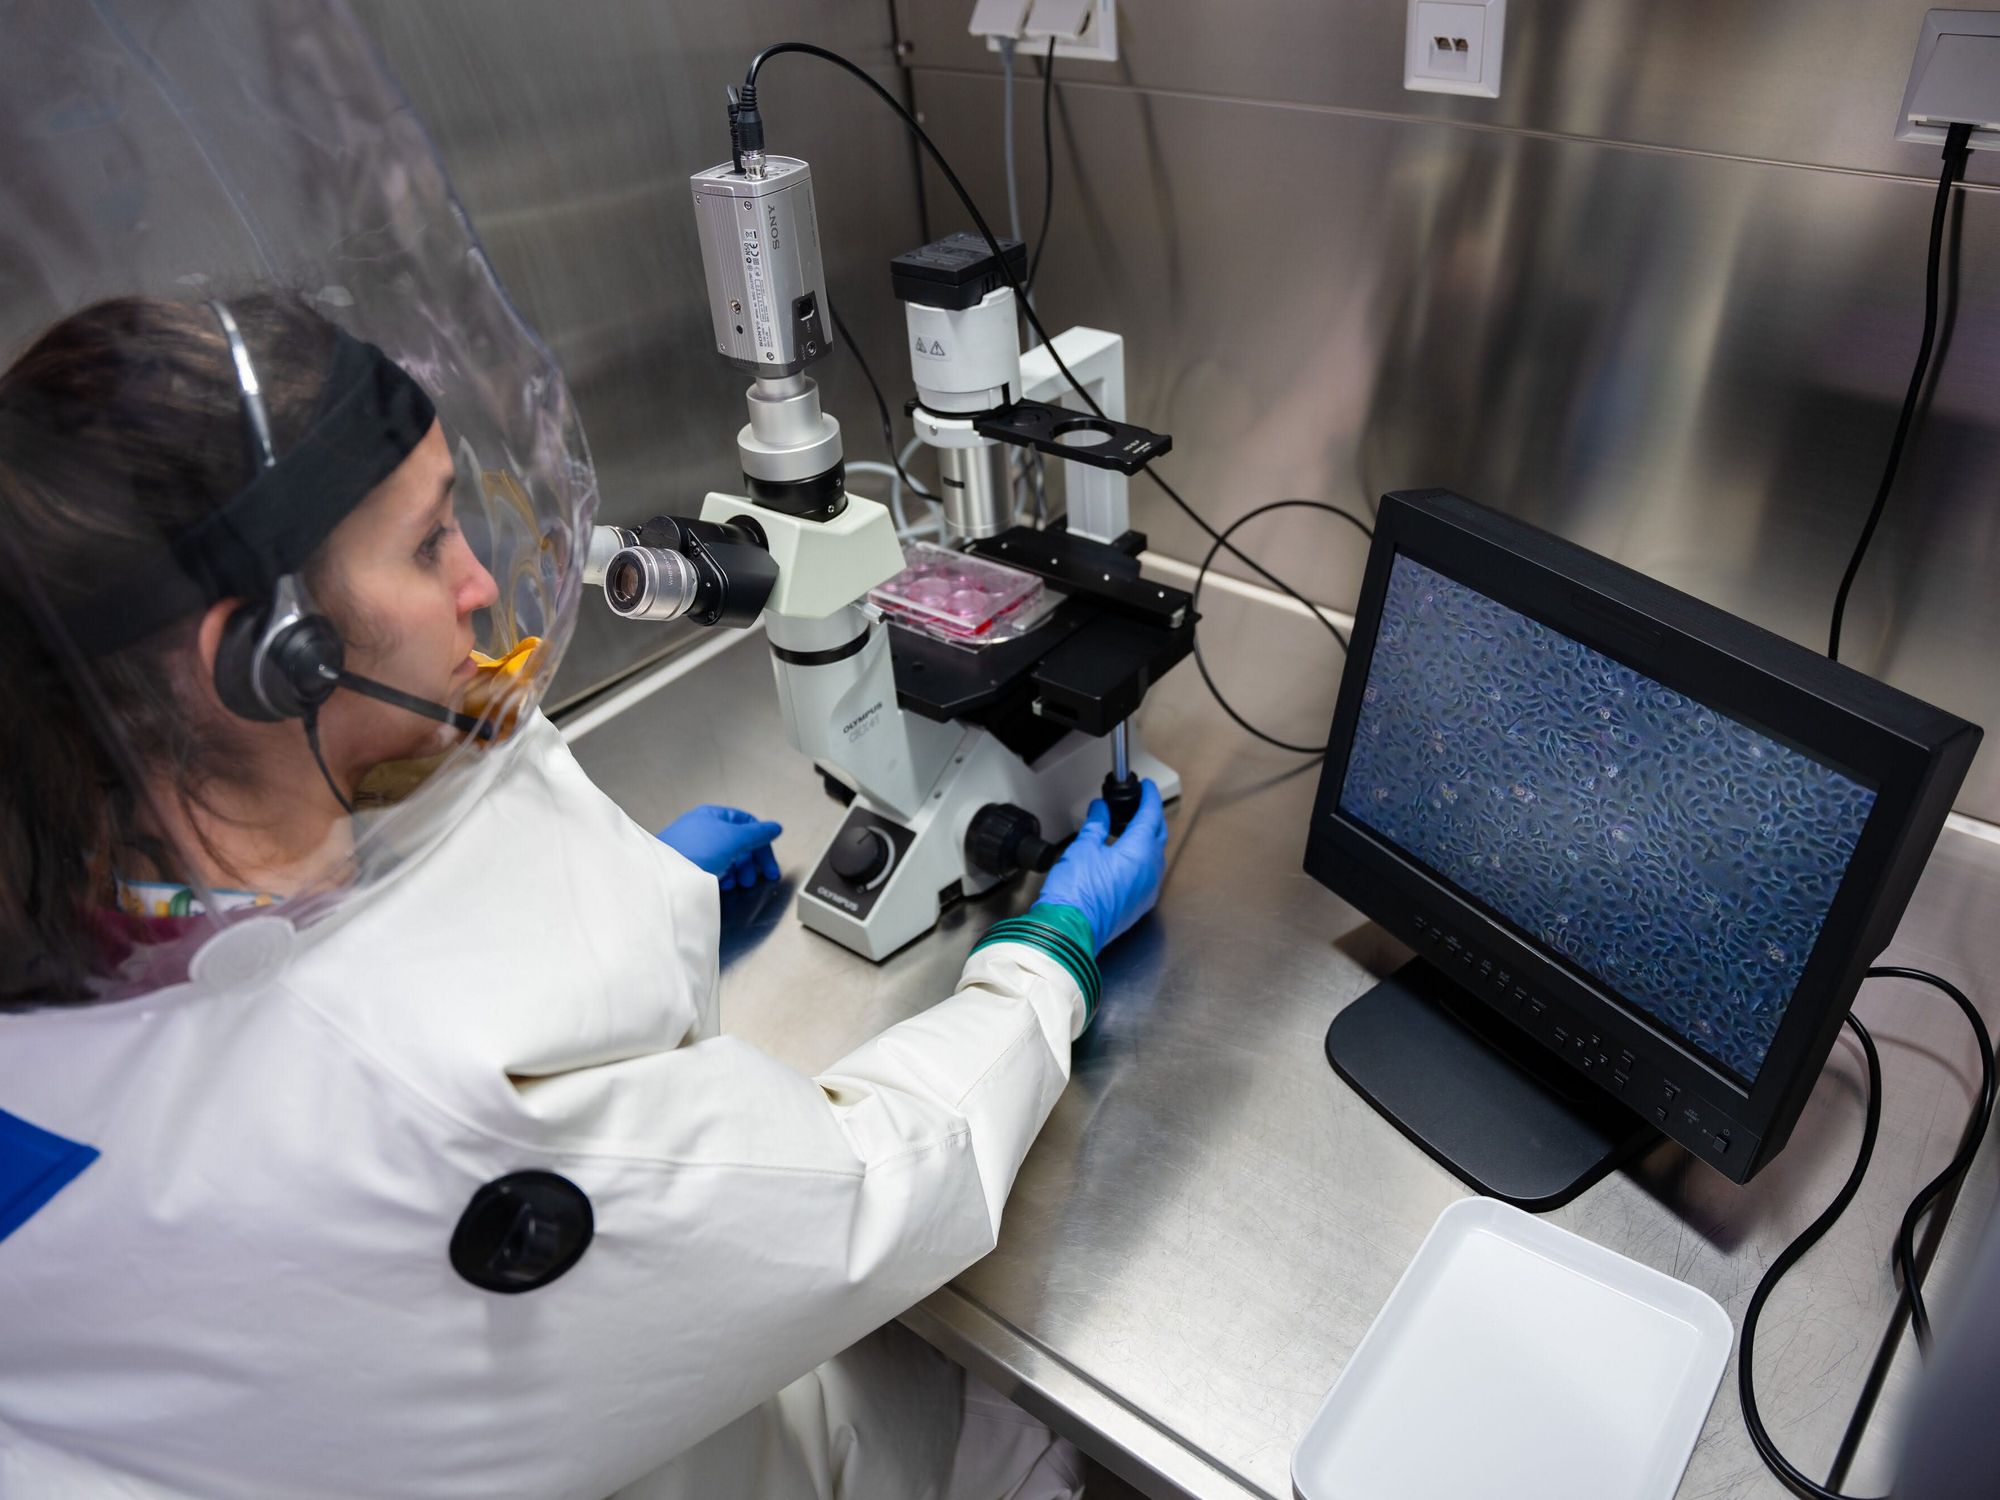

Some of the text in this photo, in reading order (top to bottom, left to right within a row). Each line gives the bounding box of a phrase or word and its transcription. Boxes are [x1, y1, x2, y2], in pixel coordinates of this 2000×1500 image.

[768, 204, 780, 250] SONY
[842, 702, 884, 734] OLYMPUS
[817, 886, 859, 912] OLYMPUS
